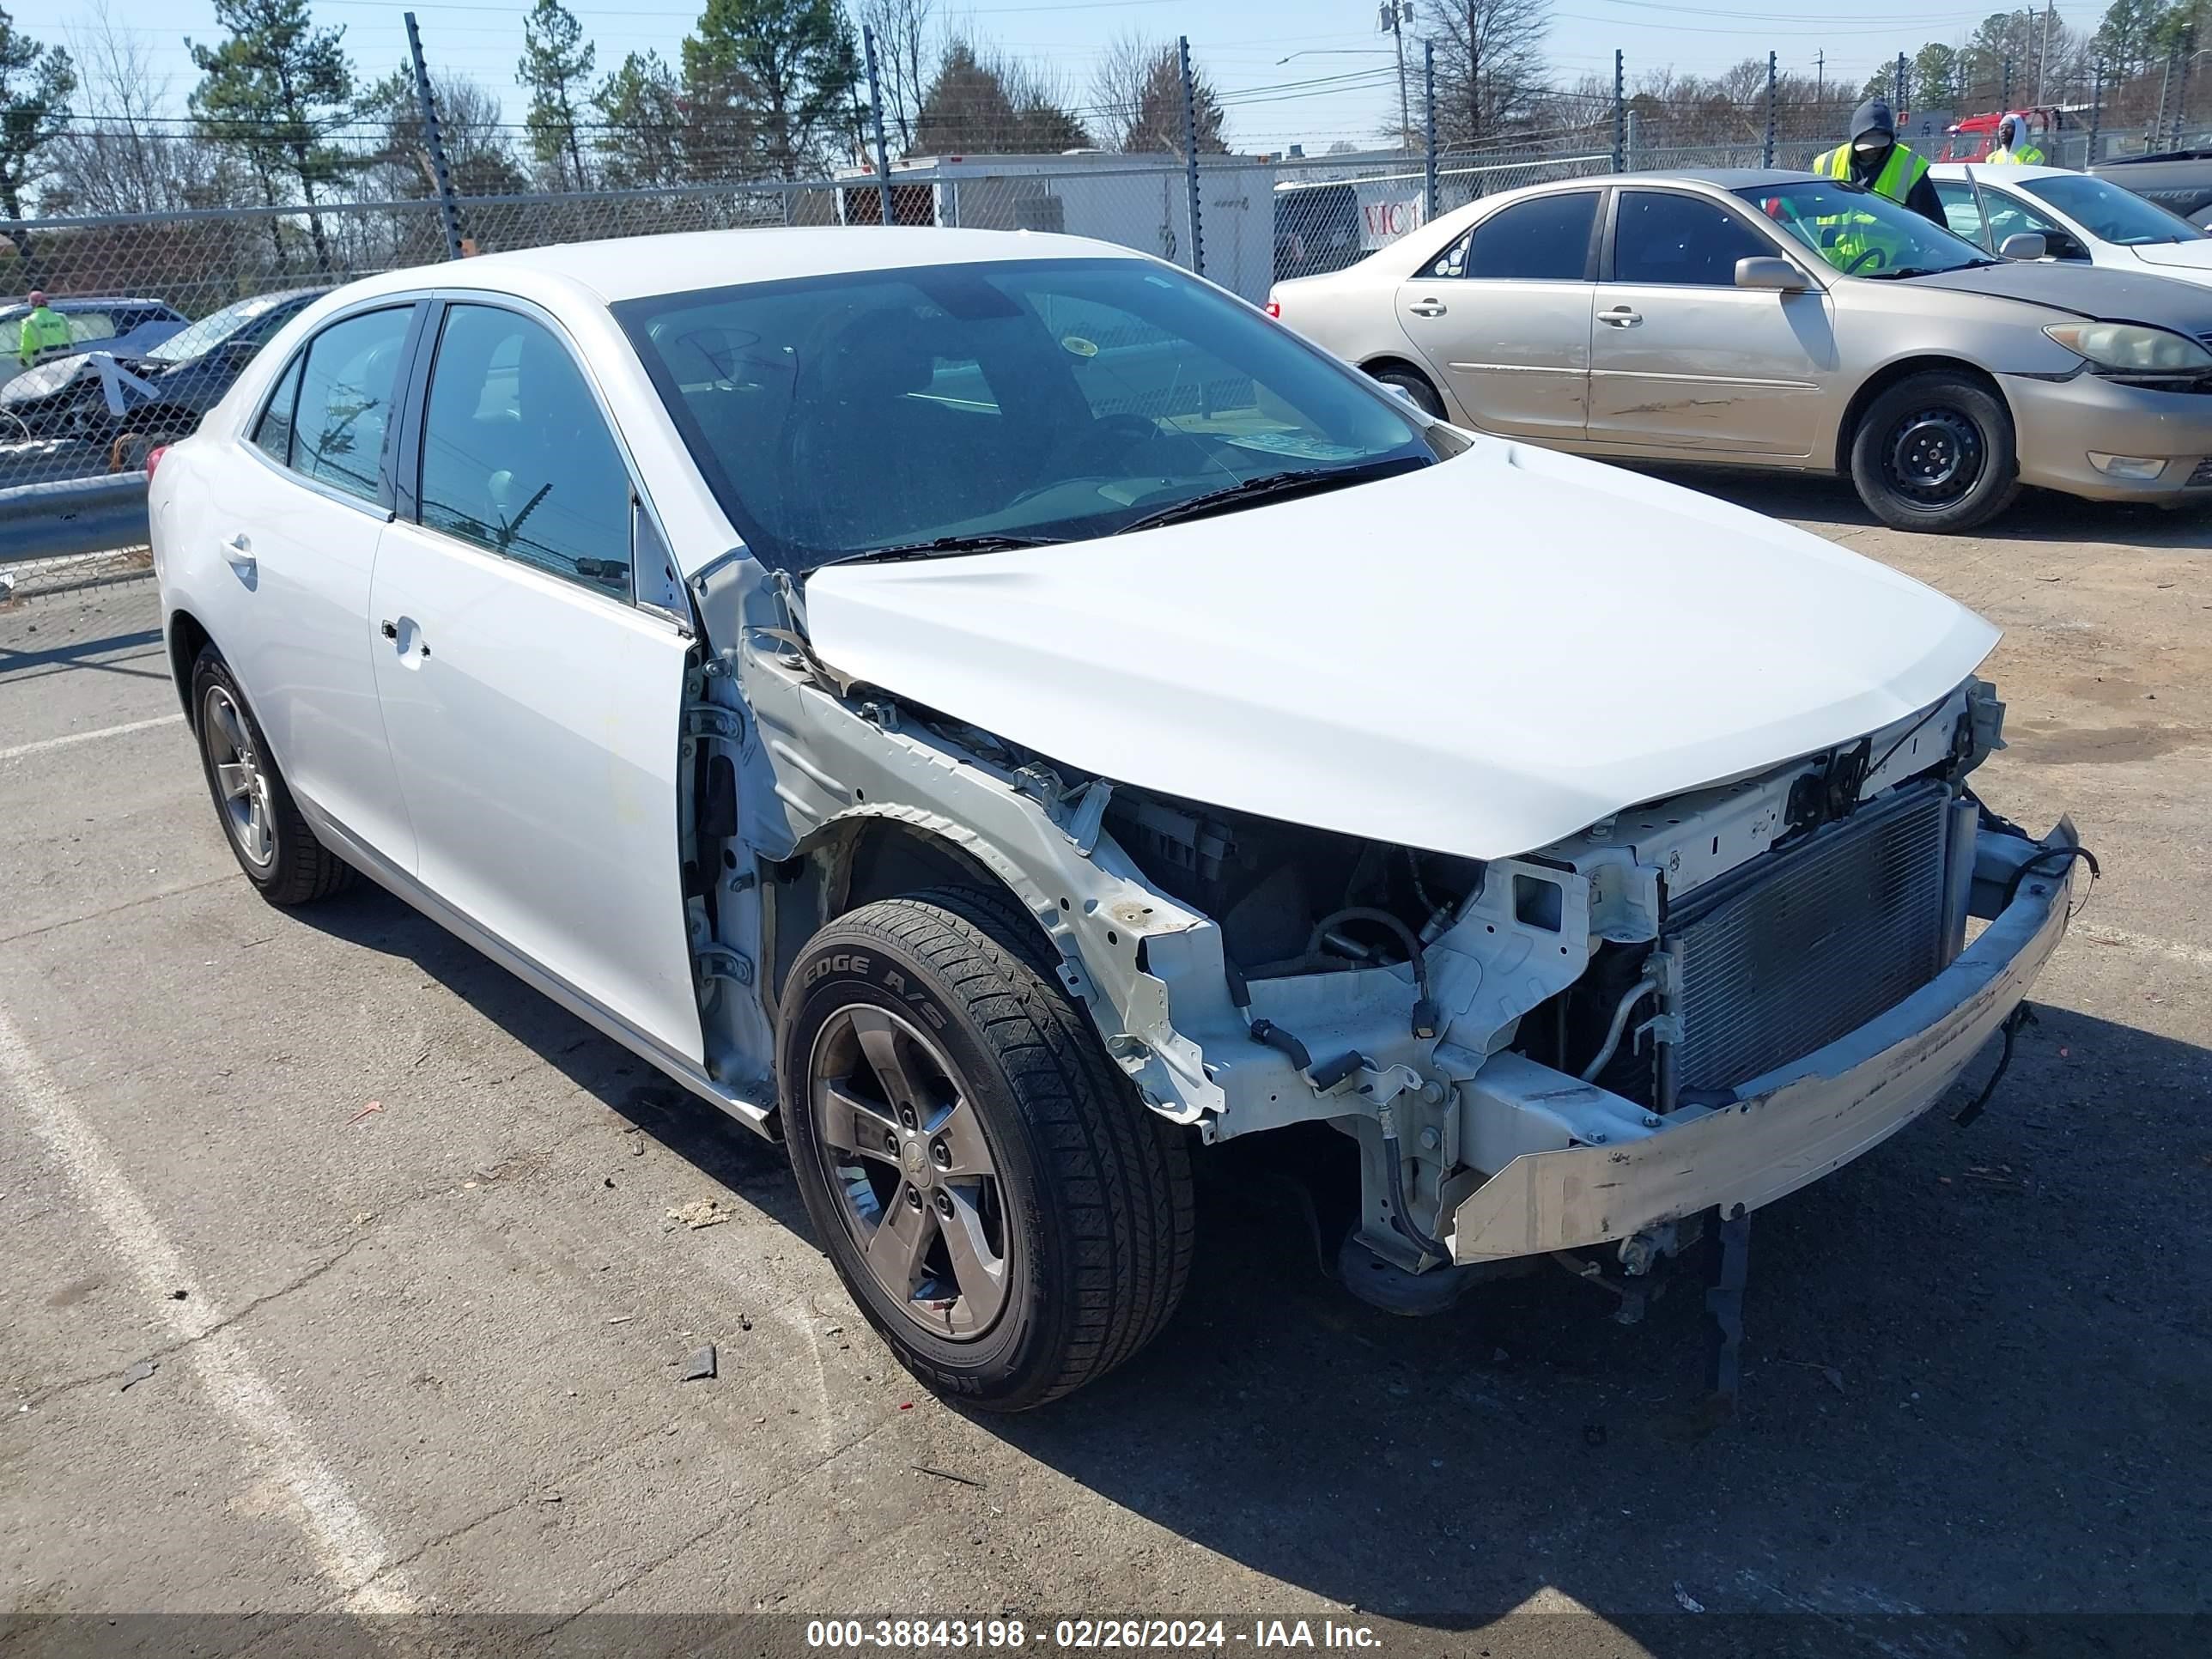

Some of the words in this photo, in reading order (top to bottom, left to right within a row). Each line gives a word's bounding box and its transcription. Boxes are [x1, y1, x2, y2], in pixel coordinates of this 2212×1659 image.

[1363, 203, 1404, 235] VIC
[803, 953, 871, 989] EDGE
[883, 969, 948, 1030] A/S
